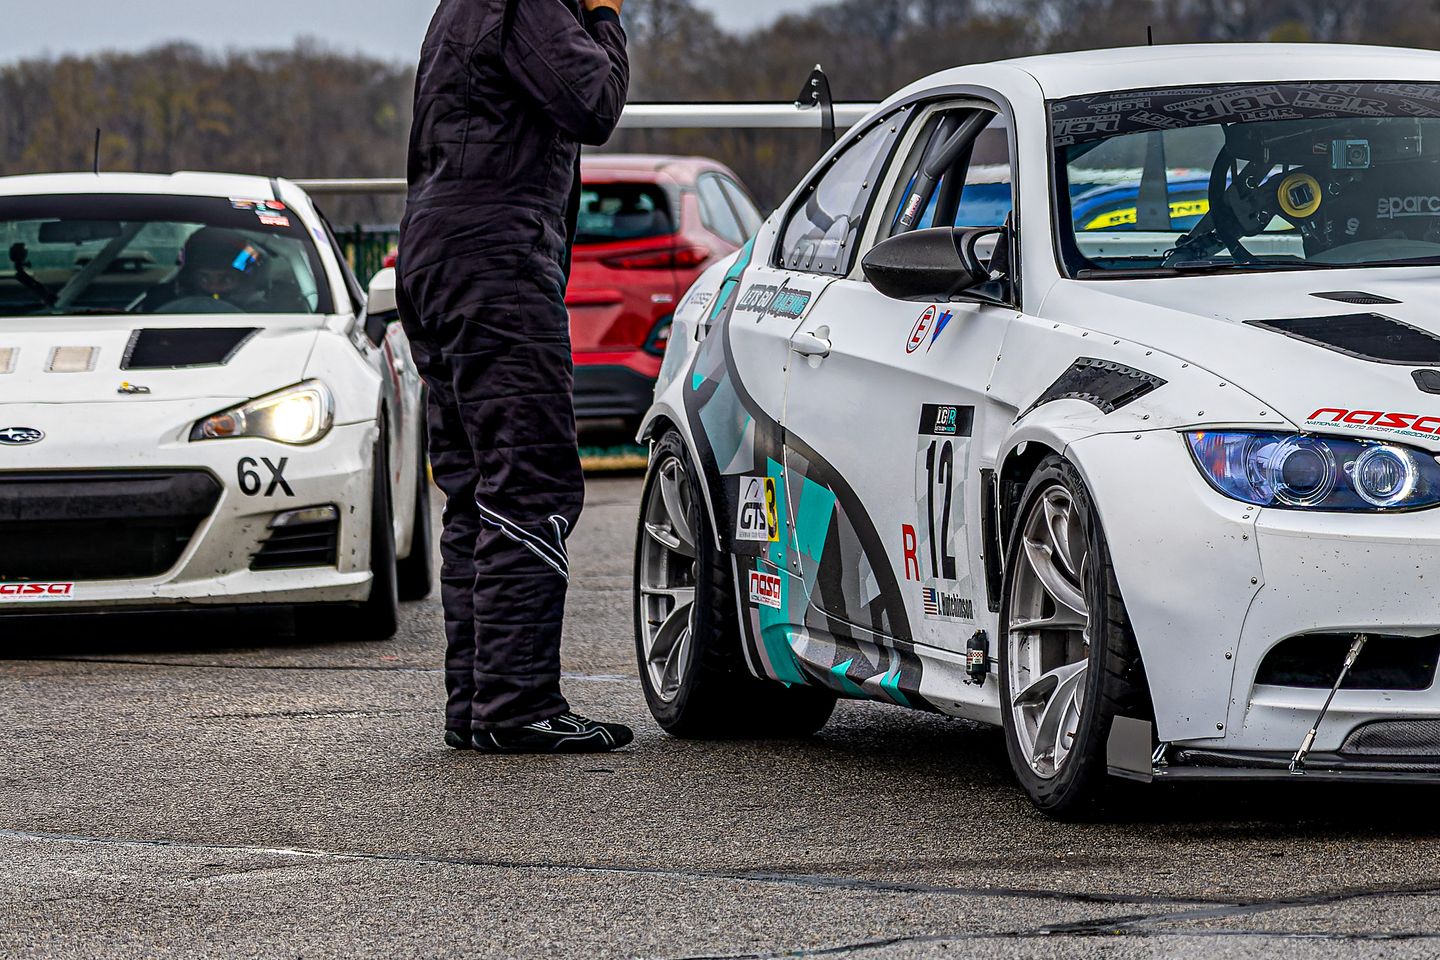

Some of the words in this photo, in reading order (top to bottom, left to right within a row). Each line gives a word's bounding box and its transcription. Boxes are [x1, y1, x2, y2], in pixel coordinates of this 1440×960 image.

[1304, 420, 1341, 428] NATIONAL
[1366, 425, 1394, 433] SPORT
[237, 456, 296, 497] 6X
[741, 501, 766, 530] GTS
[766, 478, 778, 539] 3
[926, 440, 957, 580] 12
[902, 523, 921, 582] R
